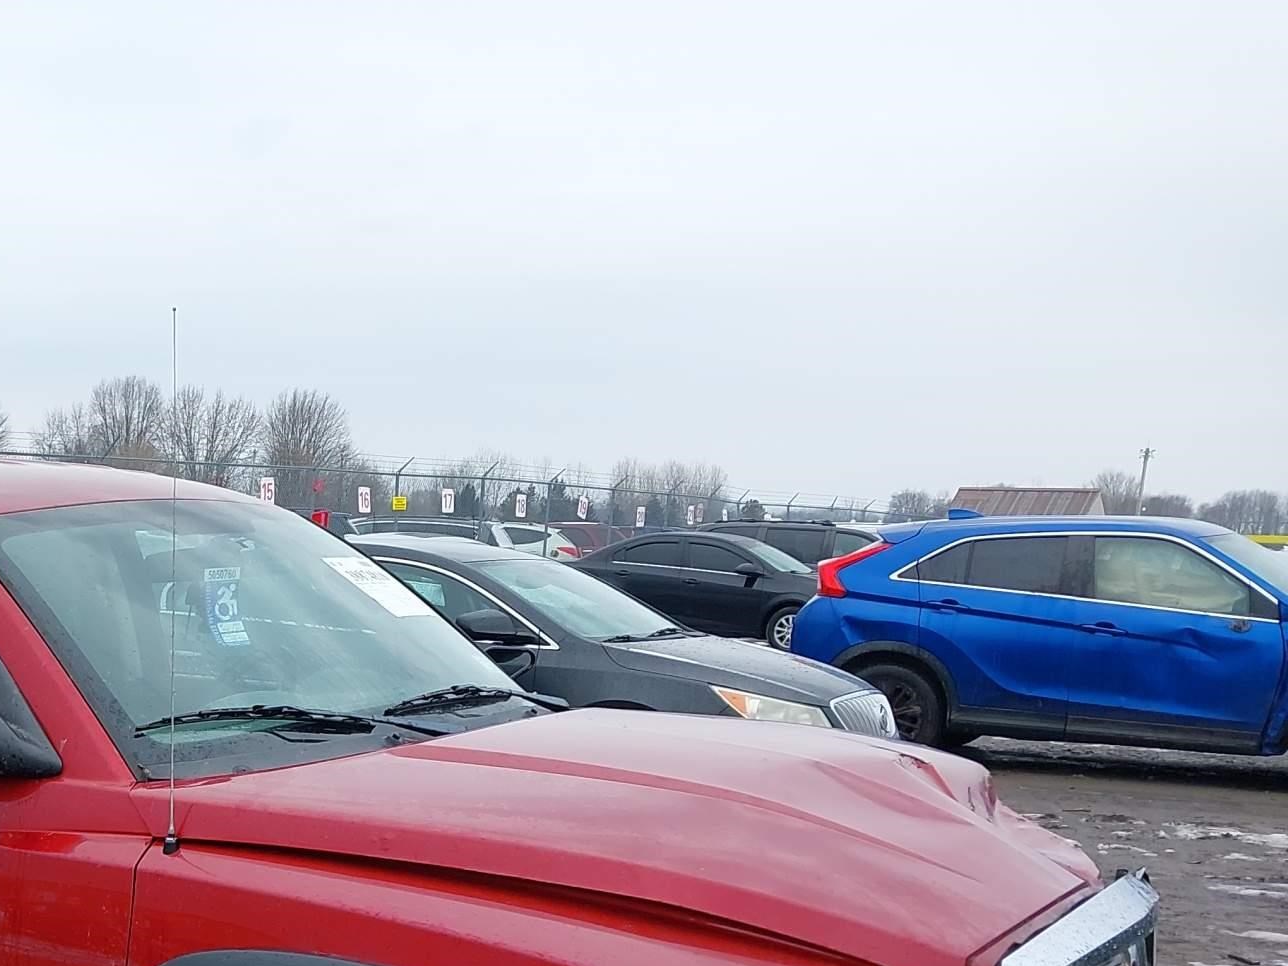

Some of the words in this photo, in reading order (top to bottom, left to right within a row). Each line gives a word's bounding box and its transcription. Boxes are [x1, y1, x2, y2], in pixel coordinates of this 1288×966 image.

[261, 482, 273, 501] 15
[359, 491, 369, 508] 16
[443, 493, 453, 509] 17
[517, 499, 526, 513] 18
[579, 501, 587, 514] 19
